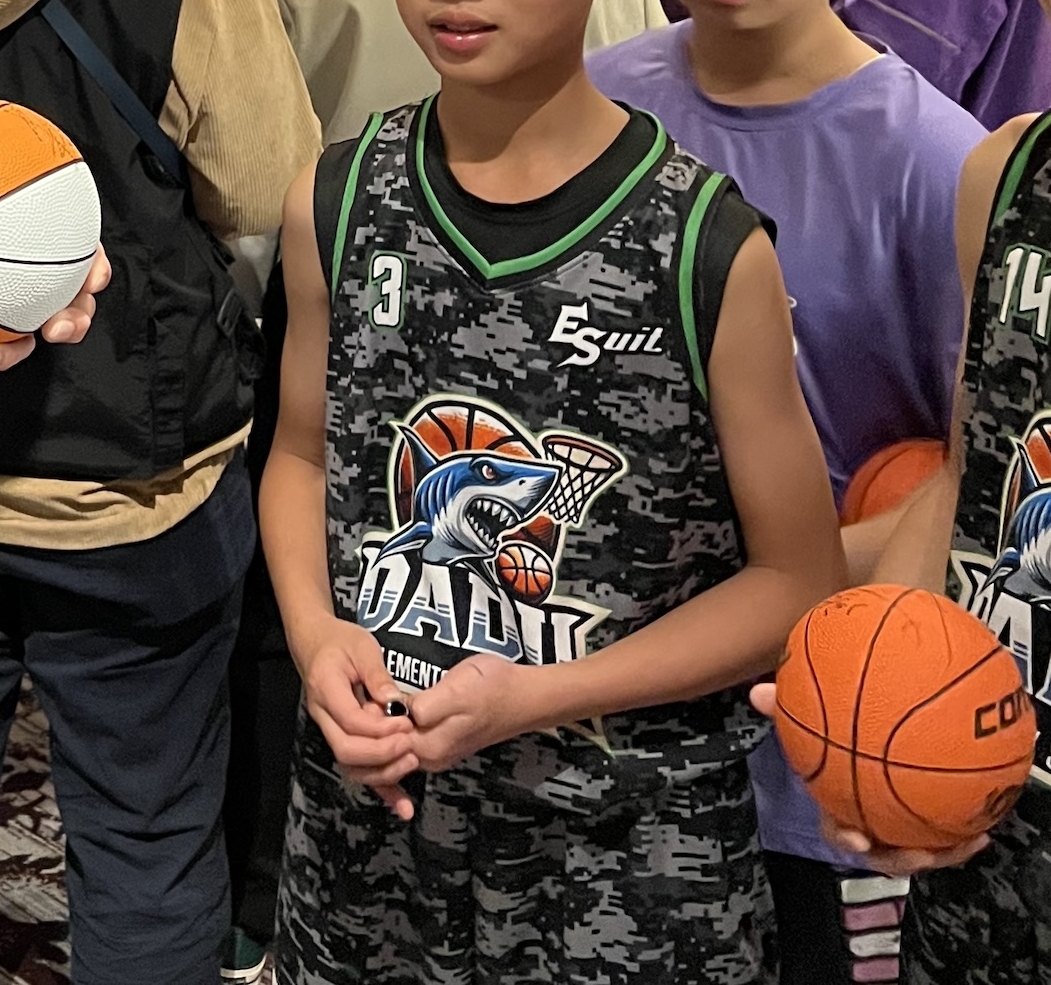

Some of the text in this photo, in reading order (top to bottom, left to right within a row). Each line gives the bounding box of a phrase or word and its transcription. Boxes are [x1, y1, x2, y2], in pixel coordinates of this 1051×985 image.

[372, 254, 404, 327] 3
[999, 247, 1051, 338] 14
[380, 647, 448, 689] EMENT
